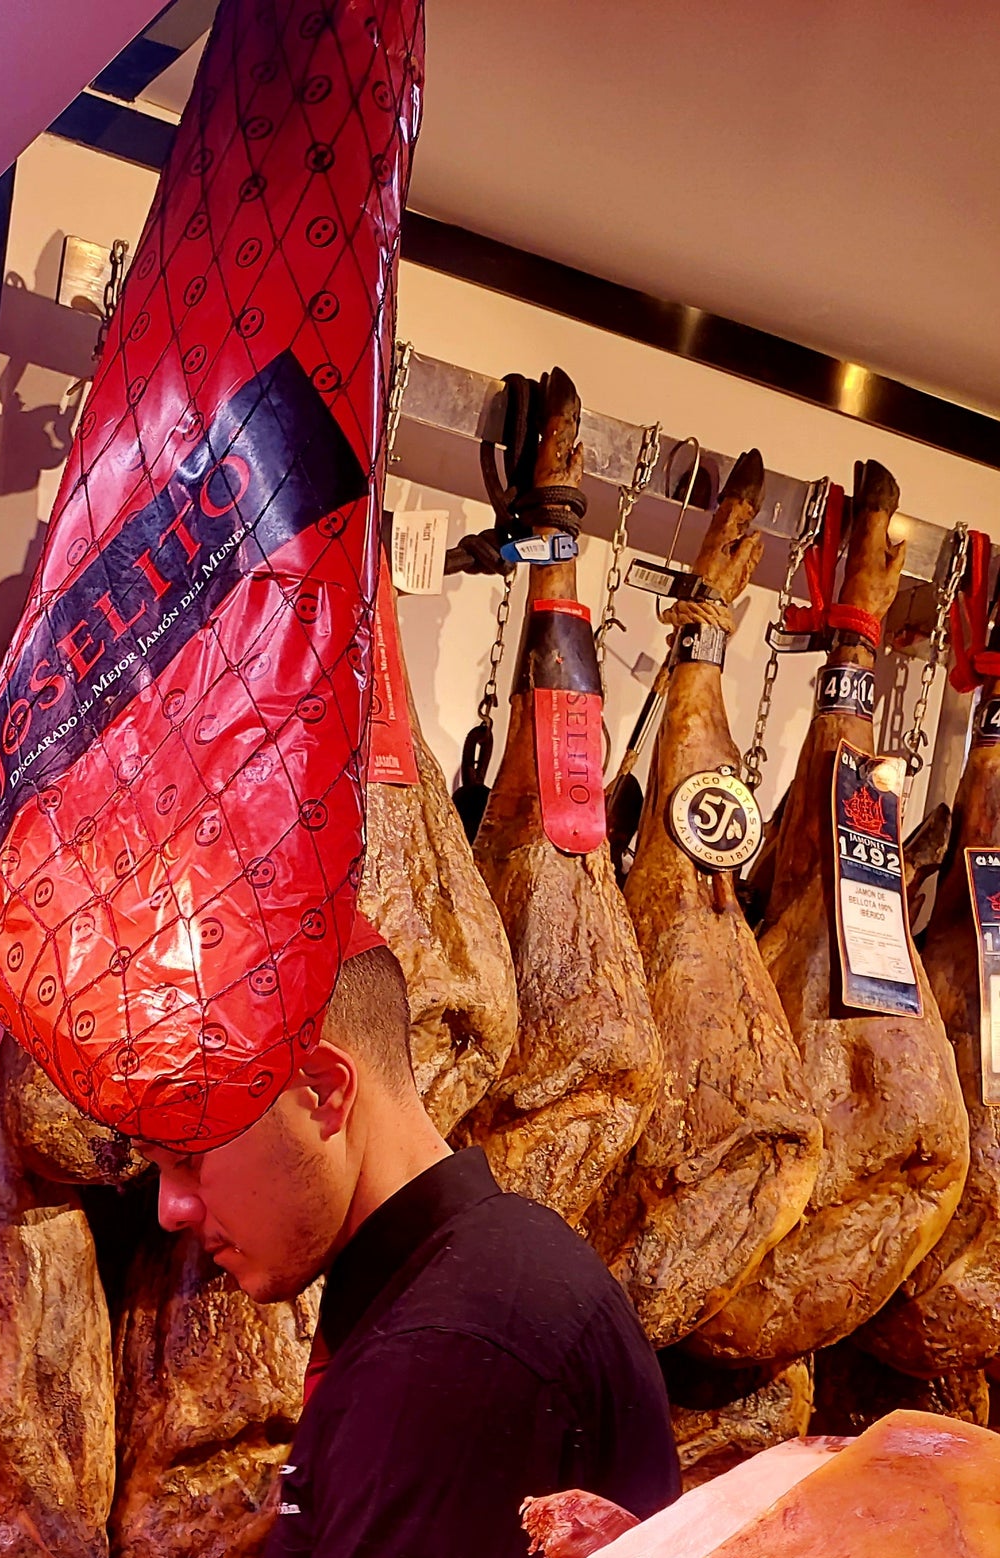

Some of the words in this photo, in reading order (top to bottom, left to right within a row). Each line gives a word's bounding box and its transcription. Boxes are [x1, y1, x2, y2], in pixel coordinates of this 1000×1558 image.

[91, 654, 139, 699] MEJOR
[136, 607, 181, 656] JAMÓN
[180, 581, 205, 610] DEL
[201, 520, 253, 580] MUNDO
[682, 777, 720, 802] CINCO
[726, 781, 757, 826] JOTAS
[676, 815, 725, 863] JABUGO
[729, 837, 755, 863] 1879
[693, 793, 741, 844] 5J
[839, 835, 901, 873] 1492
